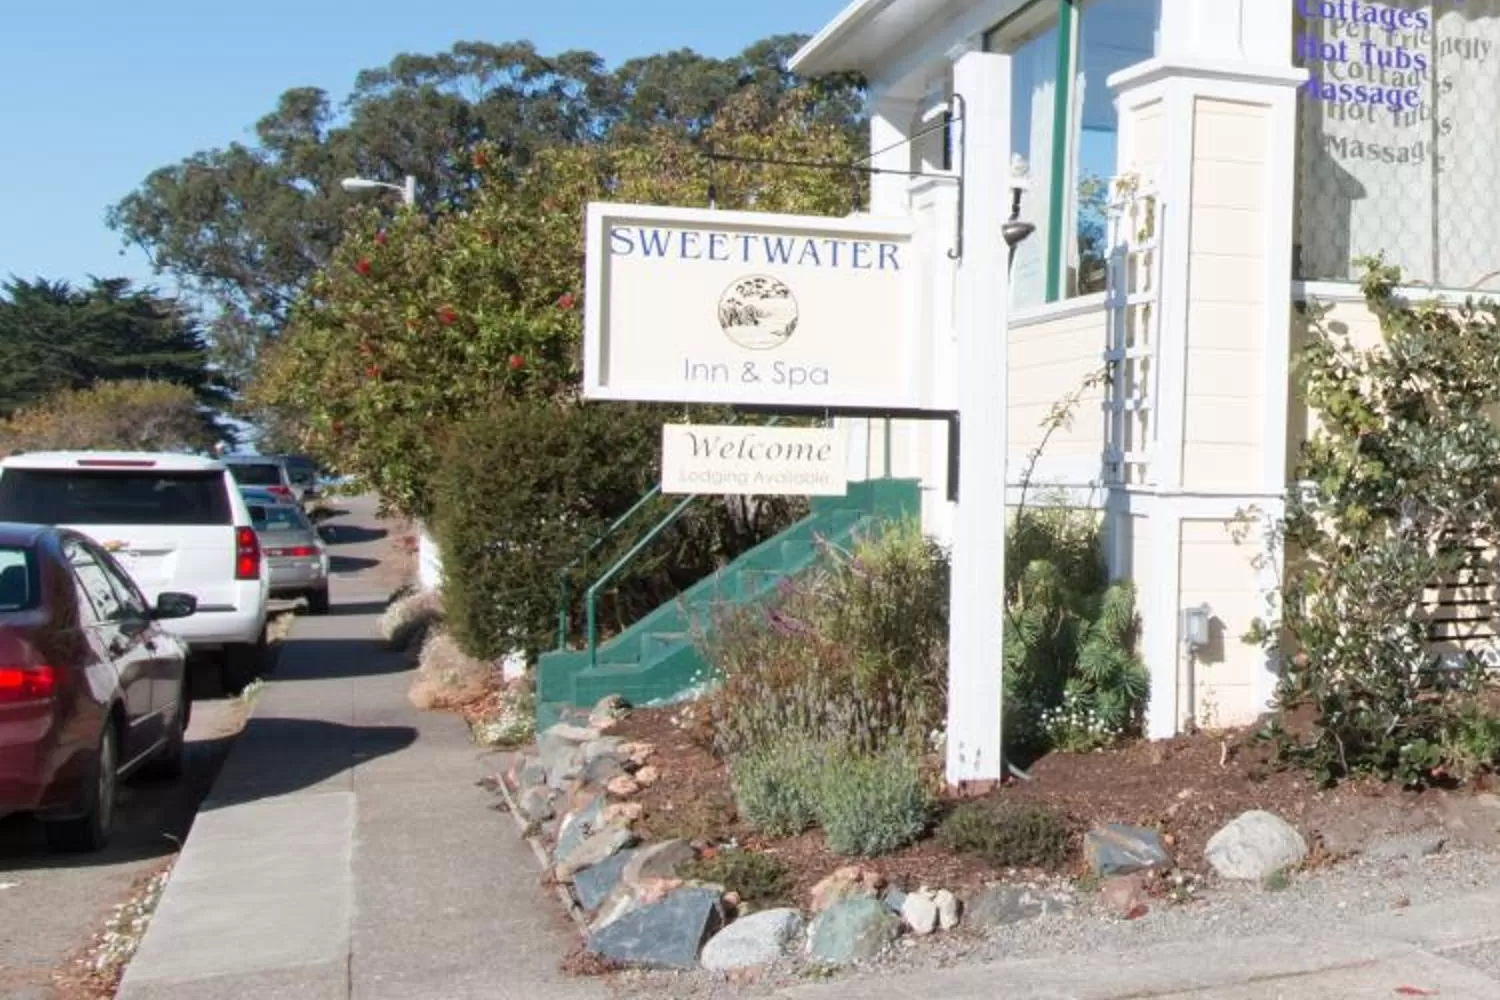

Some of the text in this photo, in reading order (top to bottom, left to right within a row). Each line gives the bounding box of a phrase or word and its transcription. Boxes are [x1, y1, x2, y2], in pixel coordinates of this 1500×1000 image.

[1296, 30, 1428, 71] Hot Tubs
[609, 226, 902, 271] SWEETWATER
[684, 357, 830, 390] Inn & Spa
[684, 431, 832, 461] Welcome
[678, 467, 752, 486] Lodging
